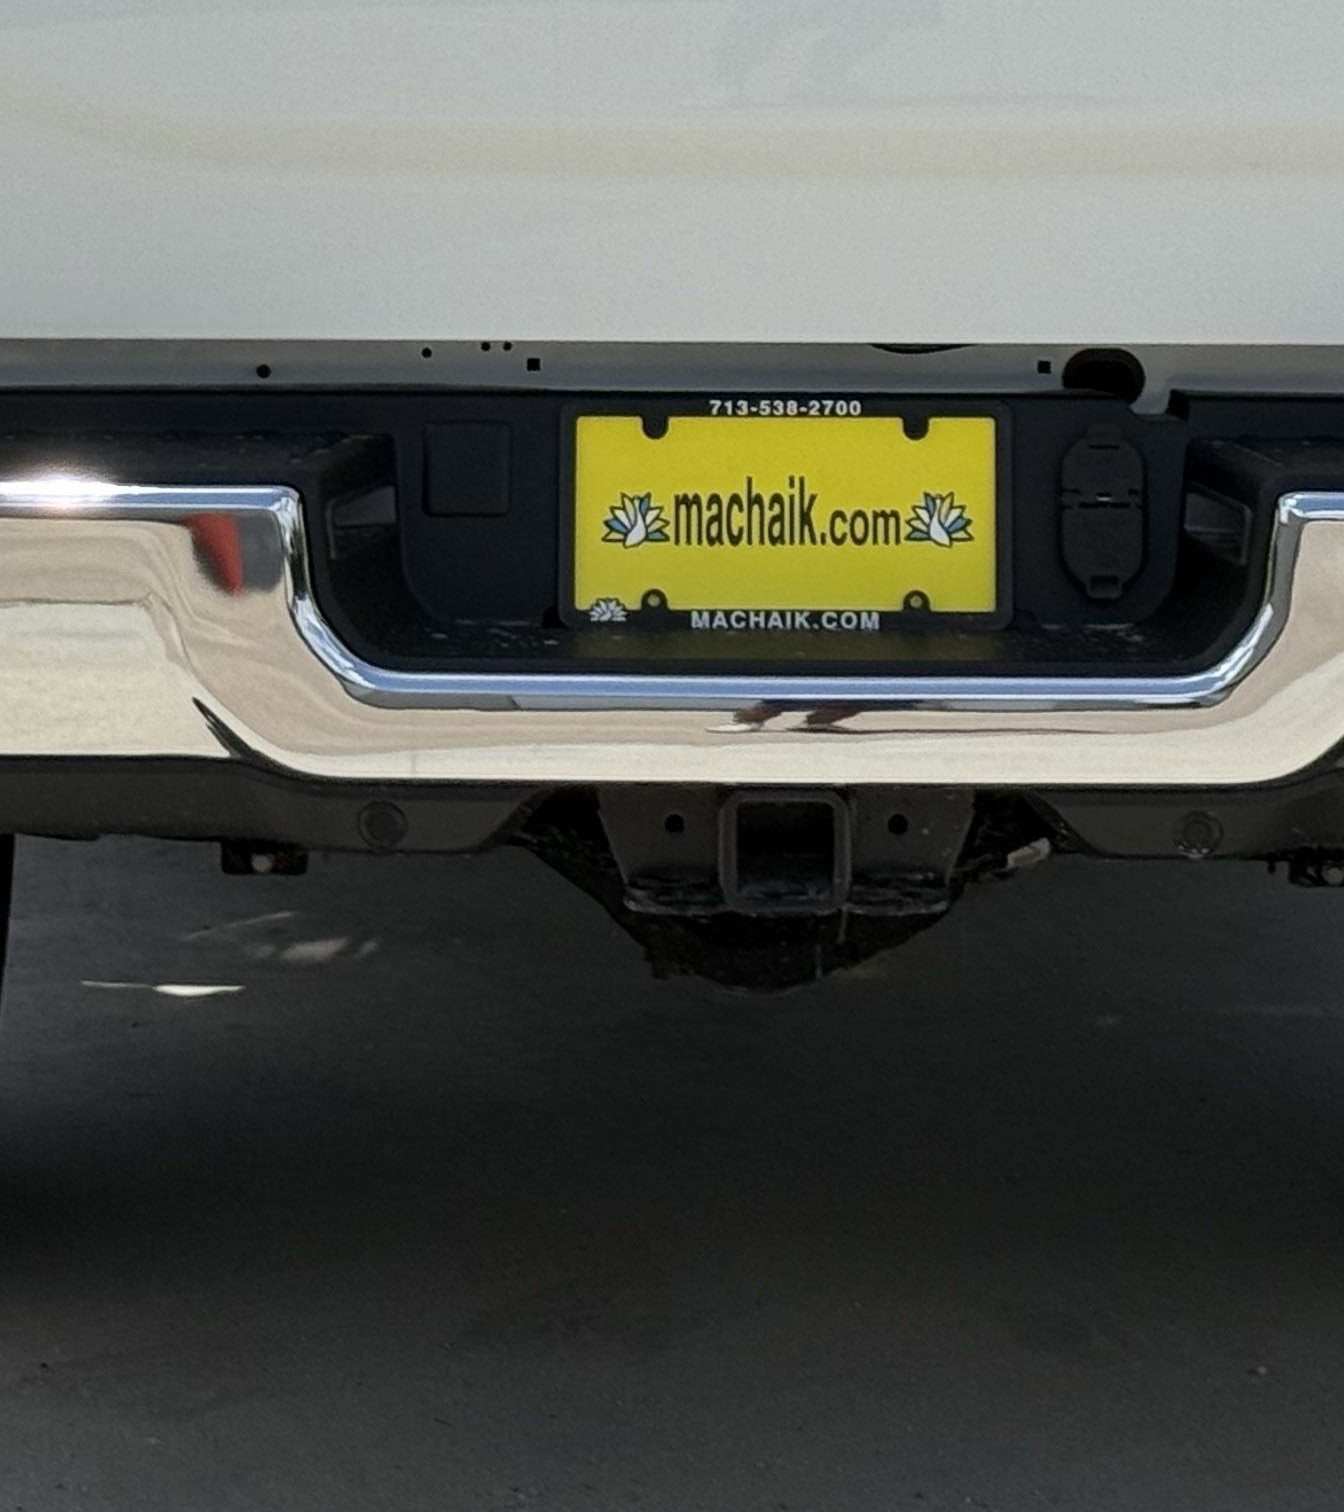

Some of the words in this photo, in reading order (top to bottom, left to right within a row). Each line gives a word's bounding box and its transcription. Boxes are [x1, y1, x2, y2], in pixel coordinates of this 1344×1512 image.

[709, 400, 862, 416] 713-538-2700
[674, 475, 902, 547] machaik.com
[691, 611, 881, 630] MACHAIK.COM
